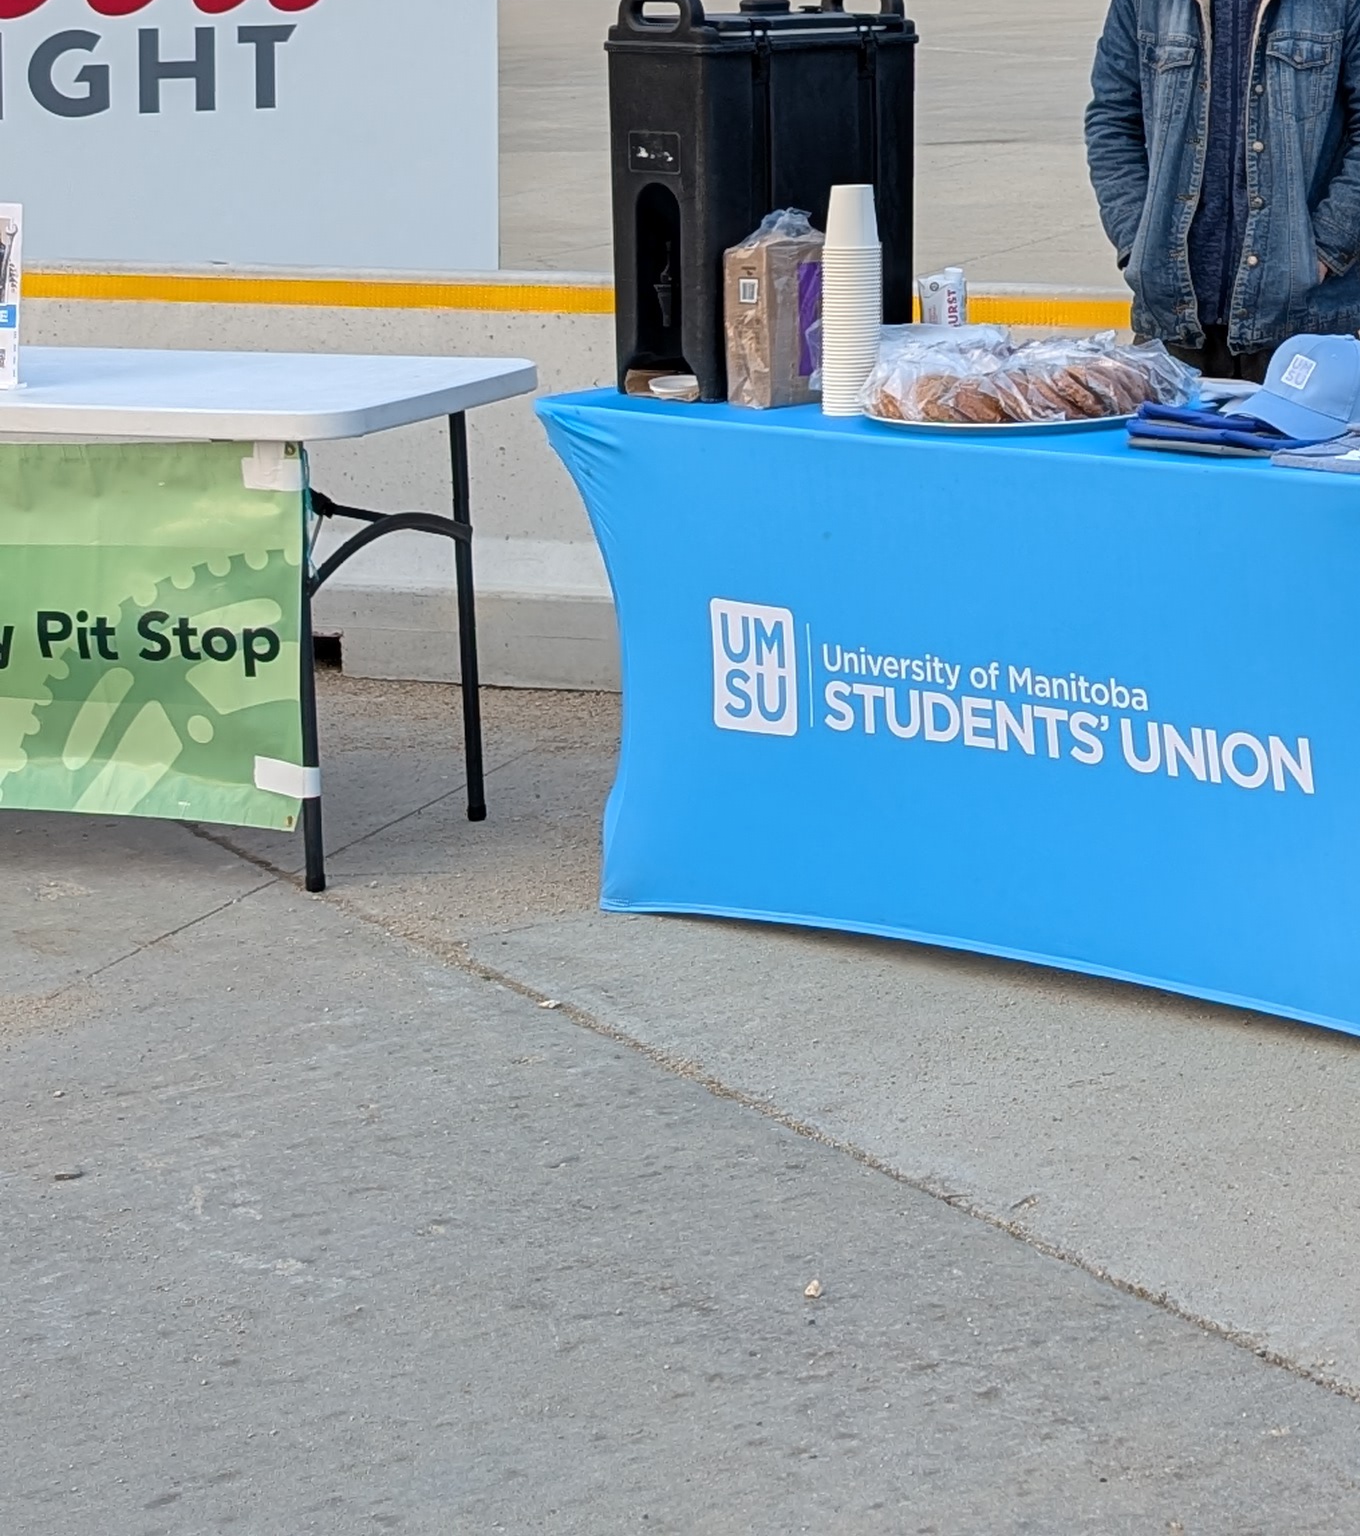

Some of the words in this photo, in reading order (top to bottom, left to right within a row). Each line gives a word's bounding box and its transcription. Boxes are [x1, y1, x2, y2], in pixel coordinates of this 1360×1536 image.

[0, 24, 297, 120] GHT
[37, 610, 119, 660] Pit
[137, 610, 281, 677] Stop
[720, 613, 787, 667] UM
[724, 668, 788, 722] SU
[822, 643, 961, 691] University
[970, 662, 1000, 691] of
[1008, 665, 1149, 712] Manitoba
[1121, 720, 1315, 795] UNION
